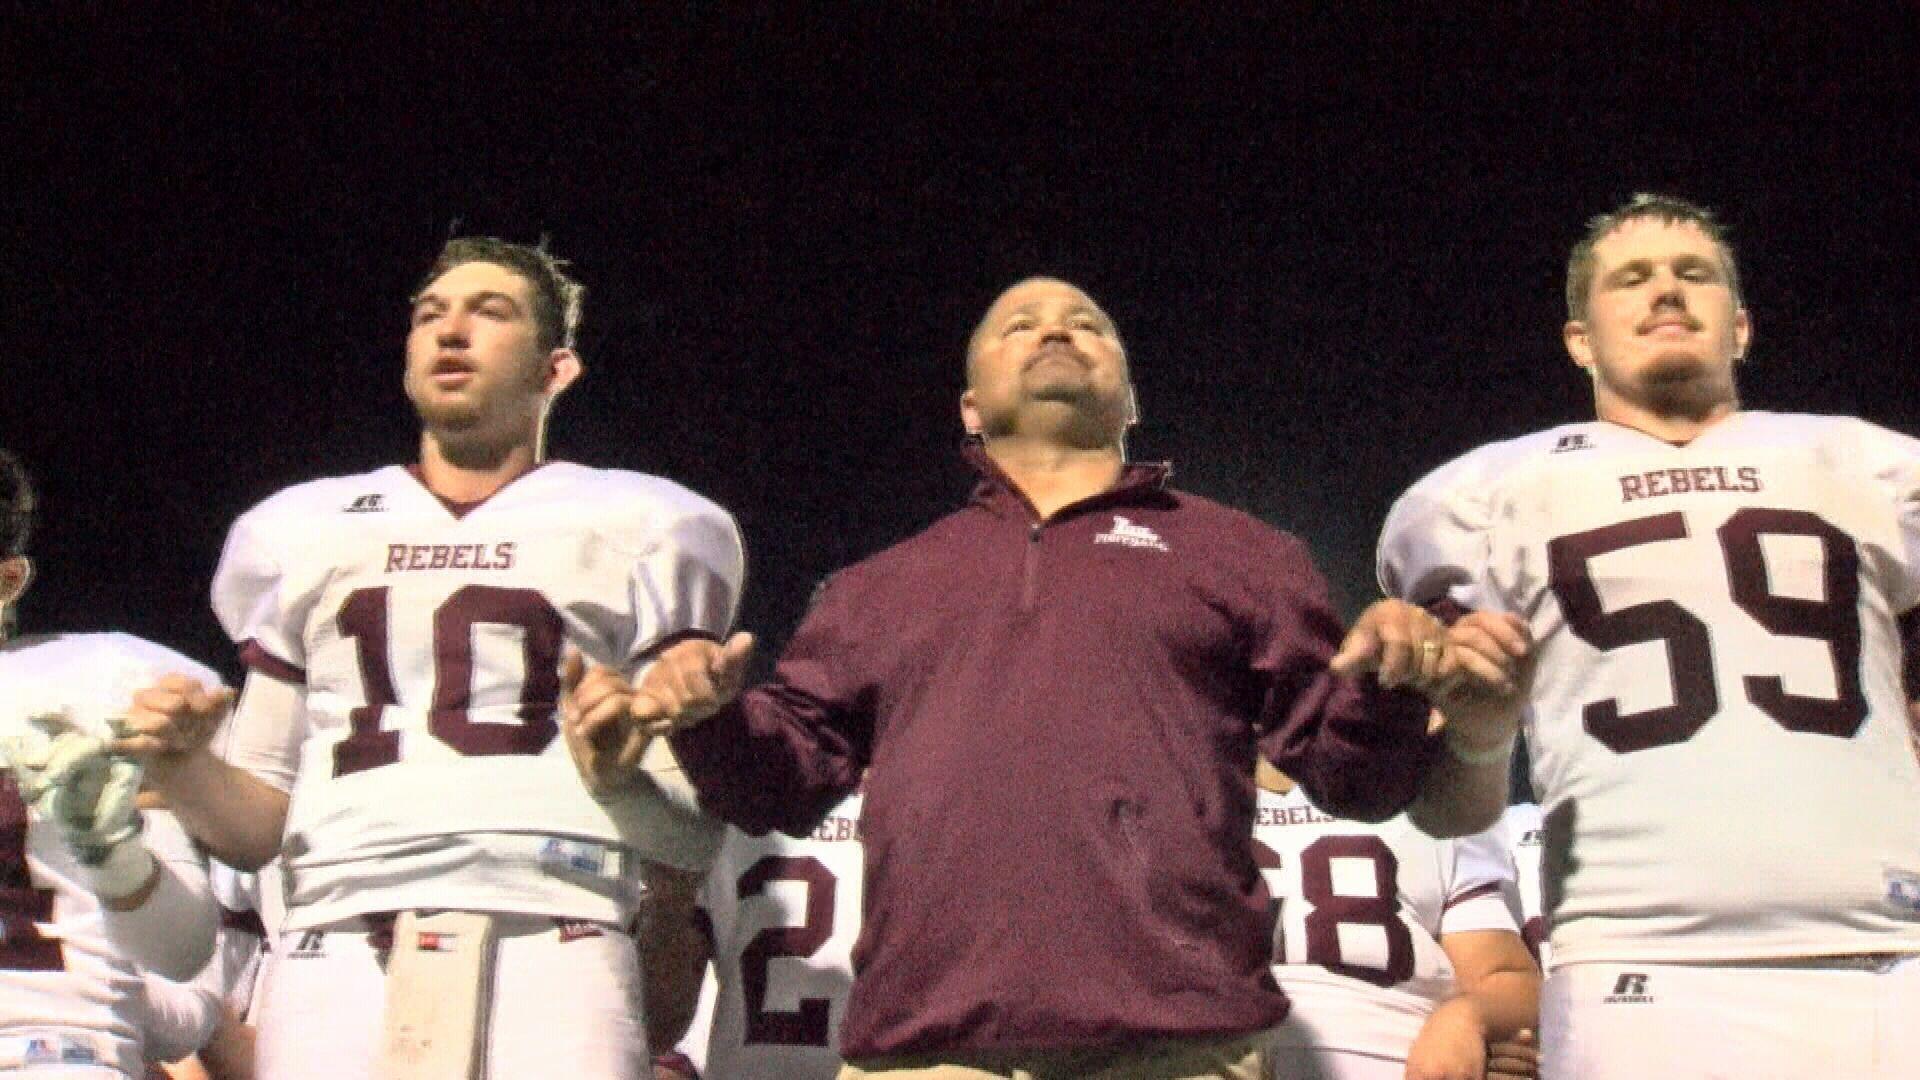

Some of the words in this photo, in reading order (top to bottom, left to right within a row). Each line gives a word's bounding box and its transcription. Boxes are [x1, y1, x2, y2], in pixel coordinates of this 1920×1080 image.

[1619, 466, 1761, 502] REBELS
[385, 542, 517, 573] REBELS
[331, 584, 565, 779] 10
[1546, 507, 1870, 754] 59
